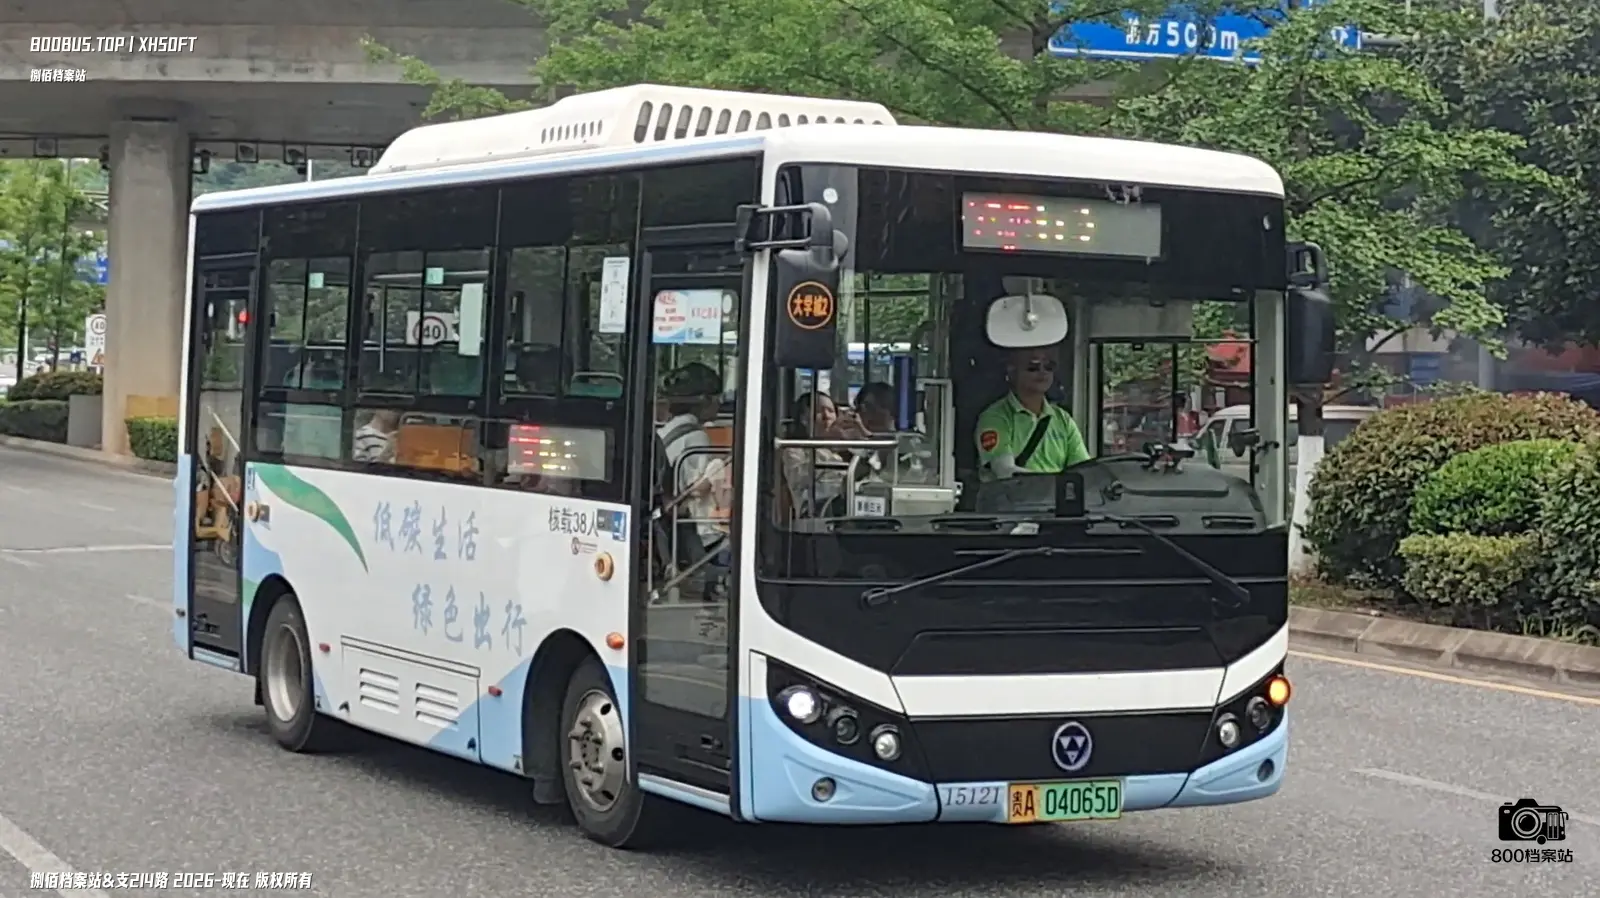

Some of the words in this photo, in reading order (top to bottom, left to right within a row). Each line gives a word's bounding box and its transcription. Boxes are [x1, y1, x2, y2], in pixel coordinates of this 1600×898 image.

[424, 325, 441, 339] 40
[373, 499, 480, 561] 低碳生活
[548, 505, 599, 538] 核载38人
[411, 582, 528, 658] 绿色出行
[945, 786, 1000, 806] 15121
